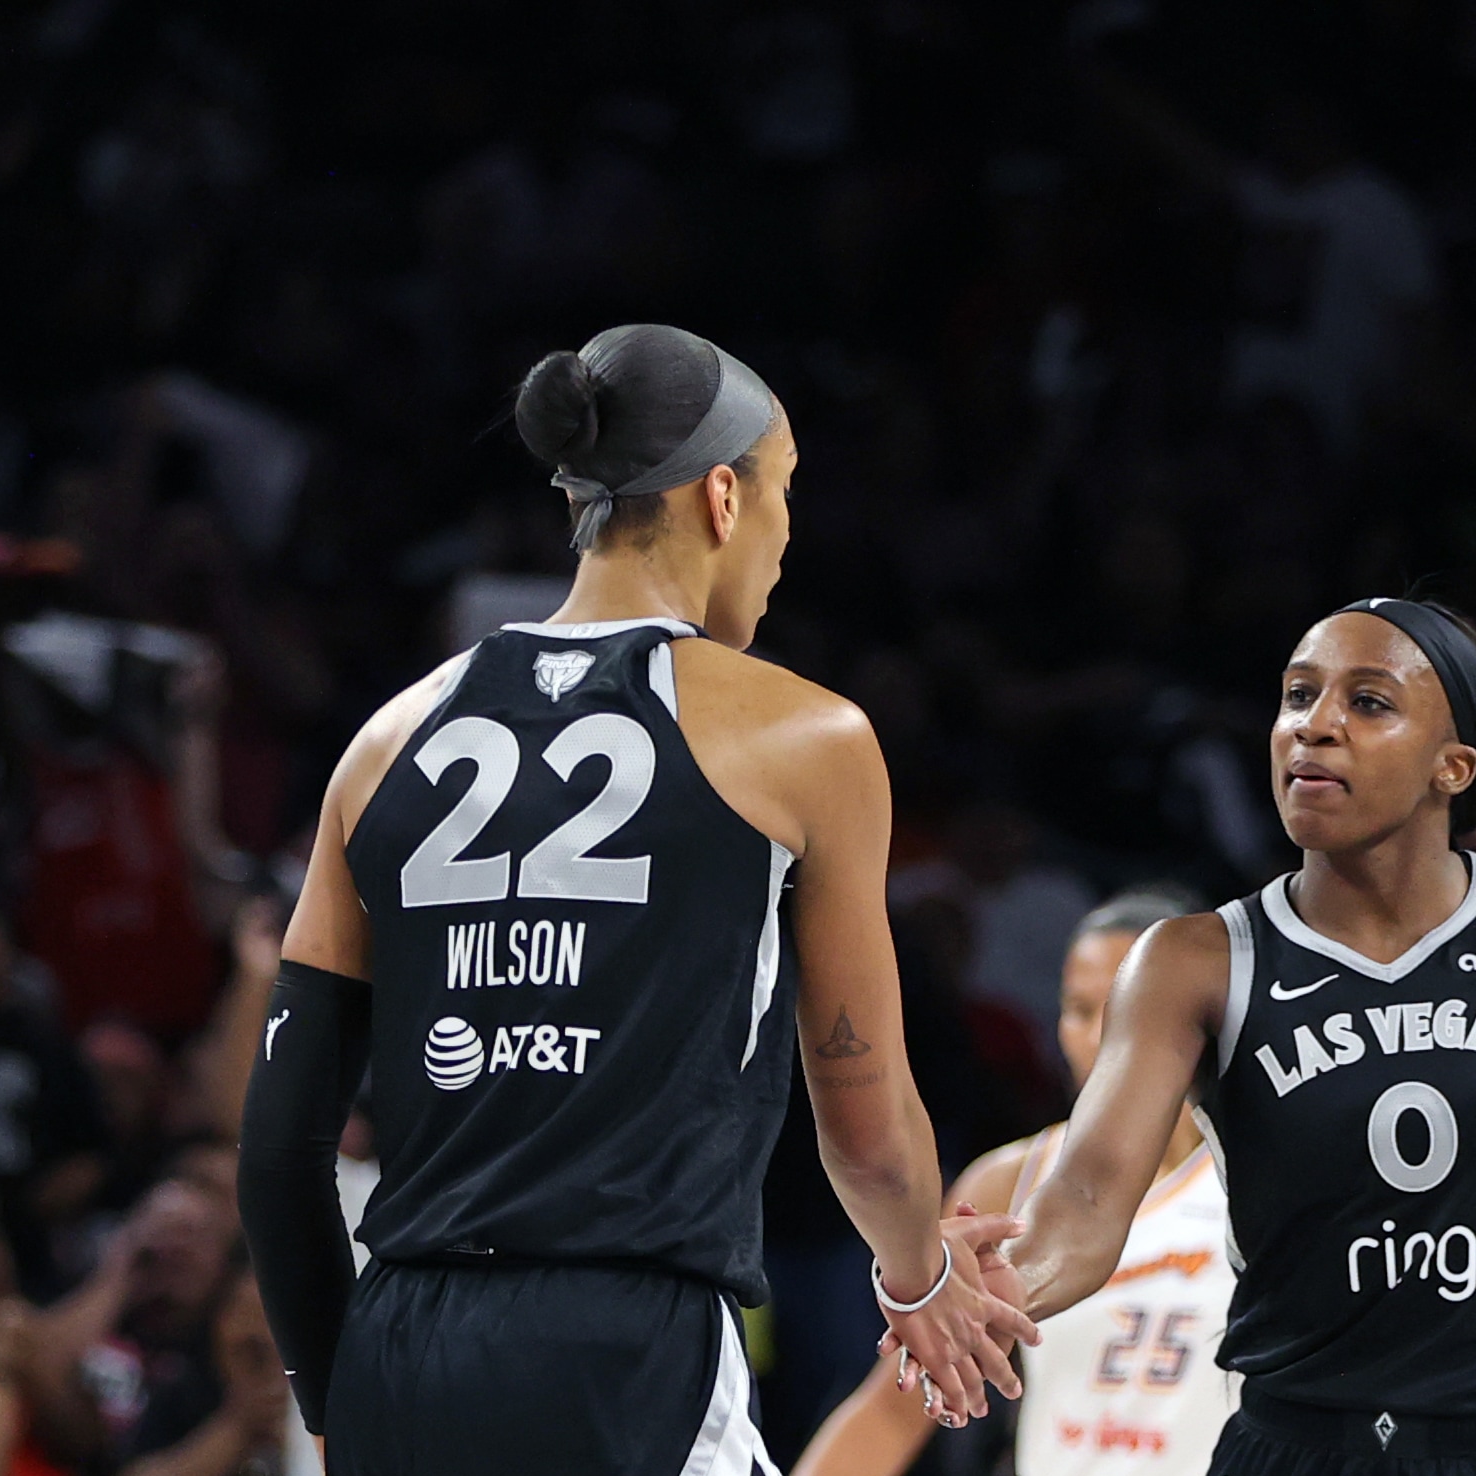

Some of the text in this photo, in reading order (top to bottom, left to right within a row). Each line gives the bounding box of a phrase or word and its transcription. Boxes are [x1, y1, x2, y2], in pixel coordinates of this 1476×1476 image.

[401, 713, 656, 908] 22
[446, 919, 587, 990] WILSON
[488, 1023, 602, 1075] AT&T
[1254, 1012, 1366, 1098] LAS
[1367, 1080, 1459, 1193] 0
[1092, 1306, 1200, 1392] 25
